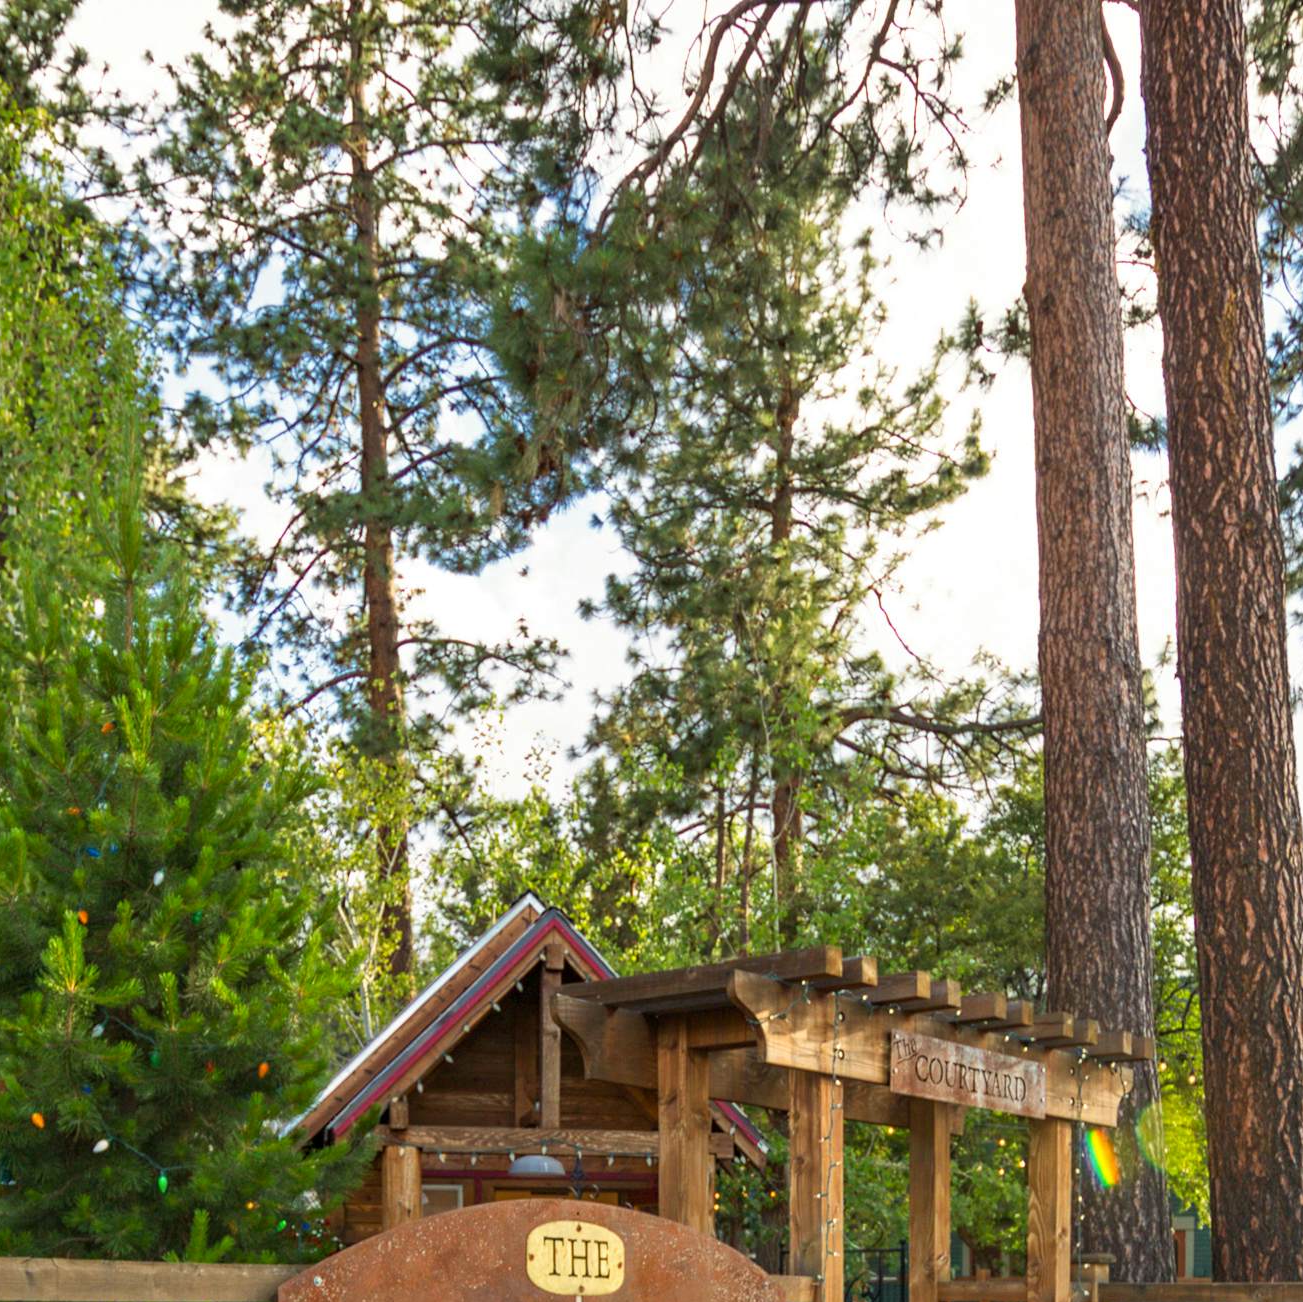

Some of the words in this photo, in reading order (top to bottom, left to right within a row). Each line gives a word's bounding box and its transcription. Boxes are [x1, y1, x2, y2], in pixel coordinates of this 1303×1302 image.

[893, 1037, 918, 1060] The
[915, 1054, 1027, 1102] COURTYARD
[543, 1236, 611, 1280] THE
